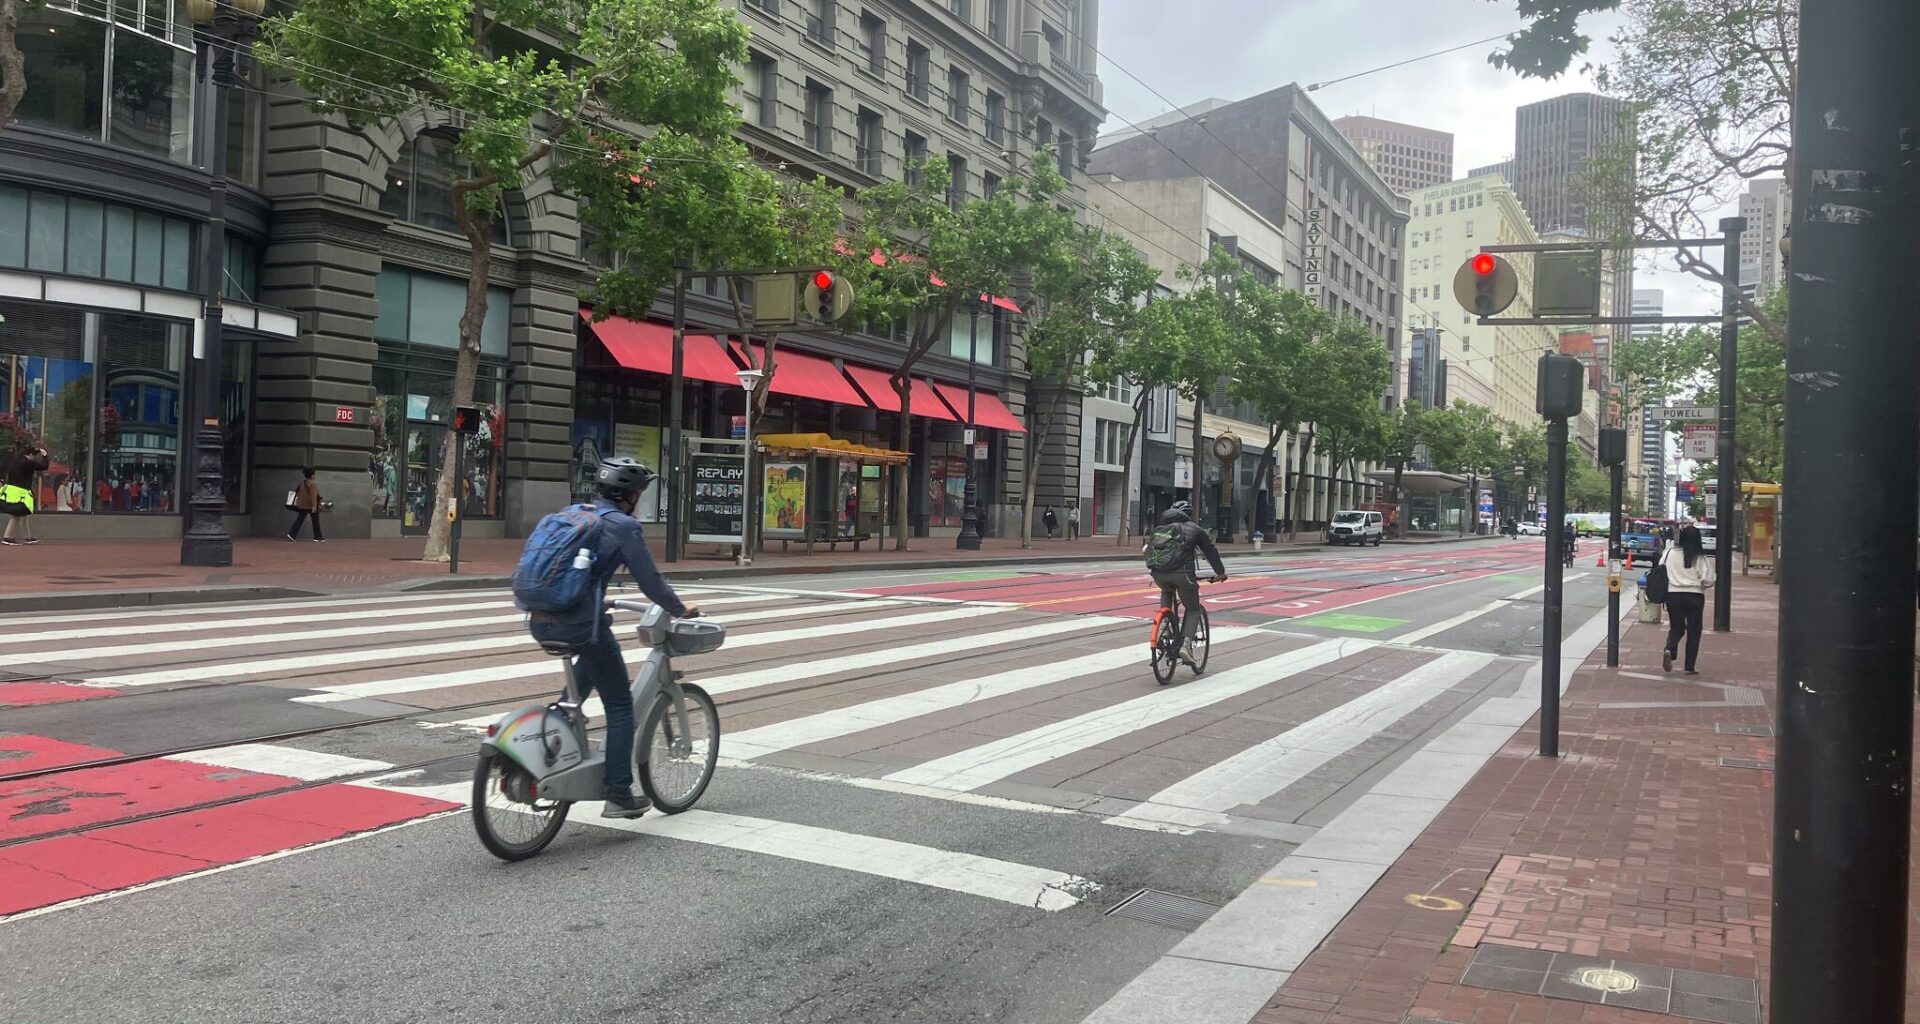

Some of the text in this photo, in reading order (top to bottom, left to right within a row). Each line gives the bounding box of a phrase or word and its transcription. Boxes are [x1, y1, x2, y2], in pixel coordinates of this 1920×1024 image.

[1424, 181, 1483, 201] PHELAN BUILDING
[1307, 210, 1320, 283] SAVING
[337, 409, 353, 420] FDC
[1663, 409, 1703, 418] POWELL
[697, 467, 743, 479] REPLAY
